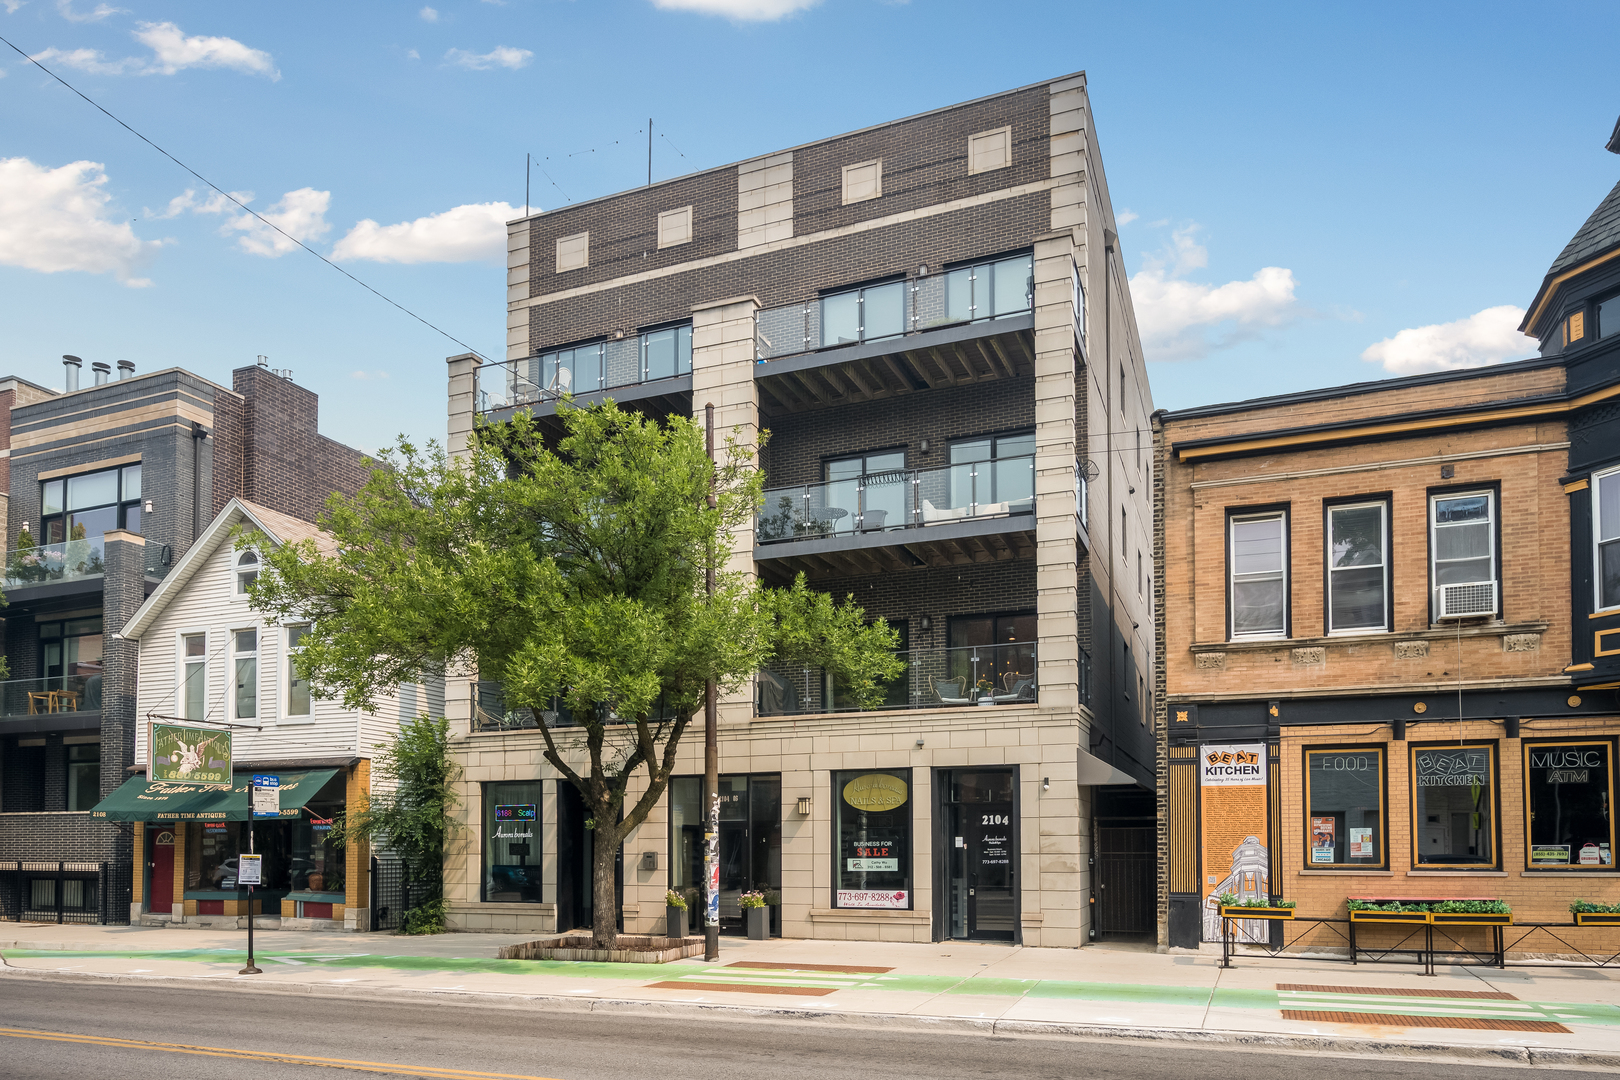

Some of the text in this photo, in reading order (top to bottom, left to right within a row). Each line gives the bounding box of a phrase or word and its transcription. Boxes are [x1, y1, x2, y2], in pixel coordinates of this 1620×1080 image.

[181, 728, 199, 742] TIME
[1207, 752, 1258, 764] BEAT
[1322, 756, 1368, 771] FOOD
[1419, 754, 1481, 771] BEAT
[1531, 751, 1600, 768] MUSIC
[1205, 765, 1260, 776] KITCHEN
[1548, 769, 1588, 783] ATM
[1419, 774, 1485, 787] KITCHEN
[145, 782, 196, 794] Father
[850, 796, 902, 805] NAILS & SPA
[517, 809, 535, 818] Scalp
[981, 814, 1009, 826] 2104
[856, 847, 889, 857] SALE
[838, 892, 890, 902] 773-697-8288
